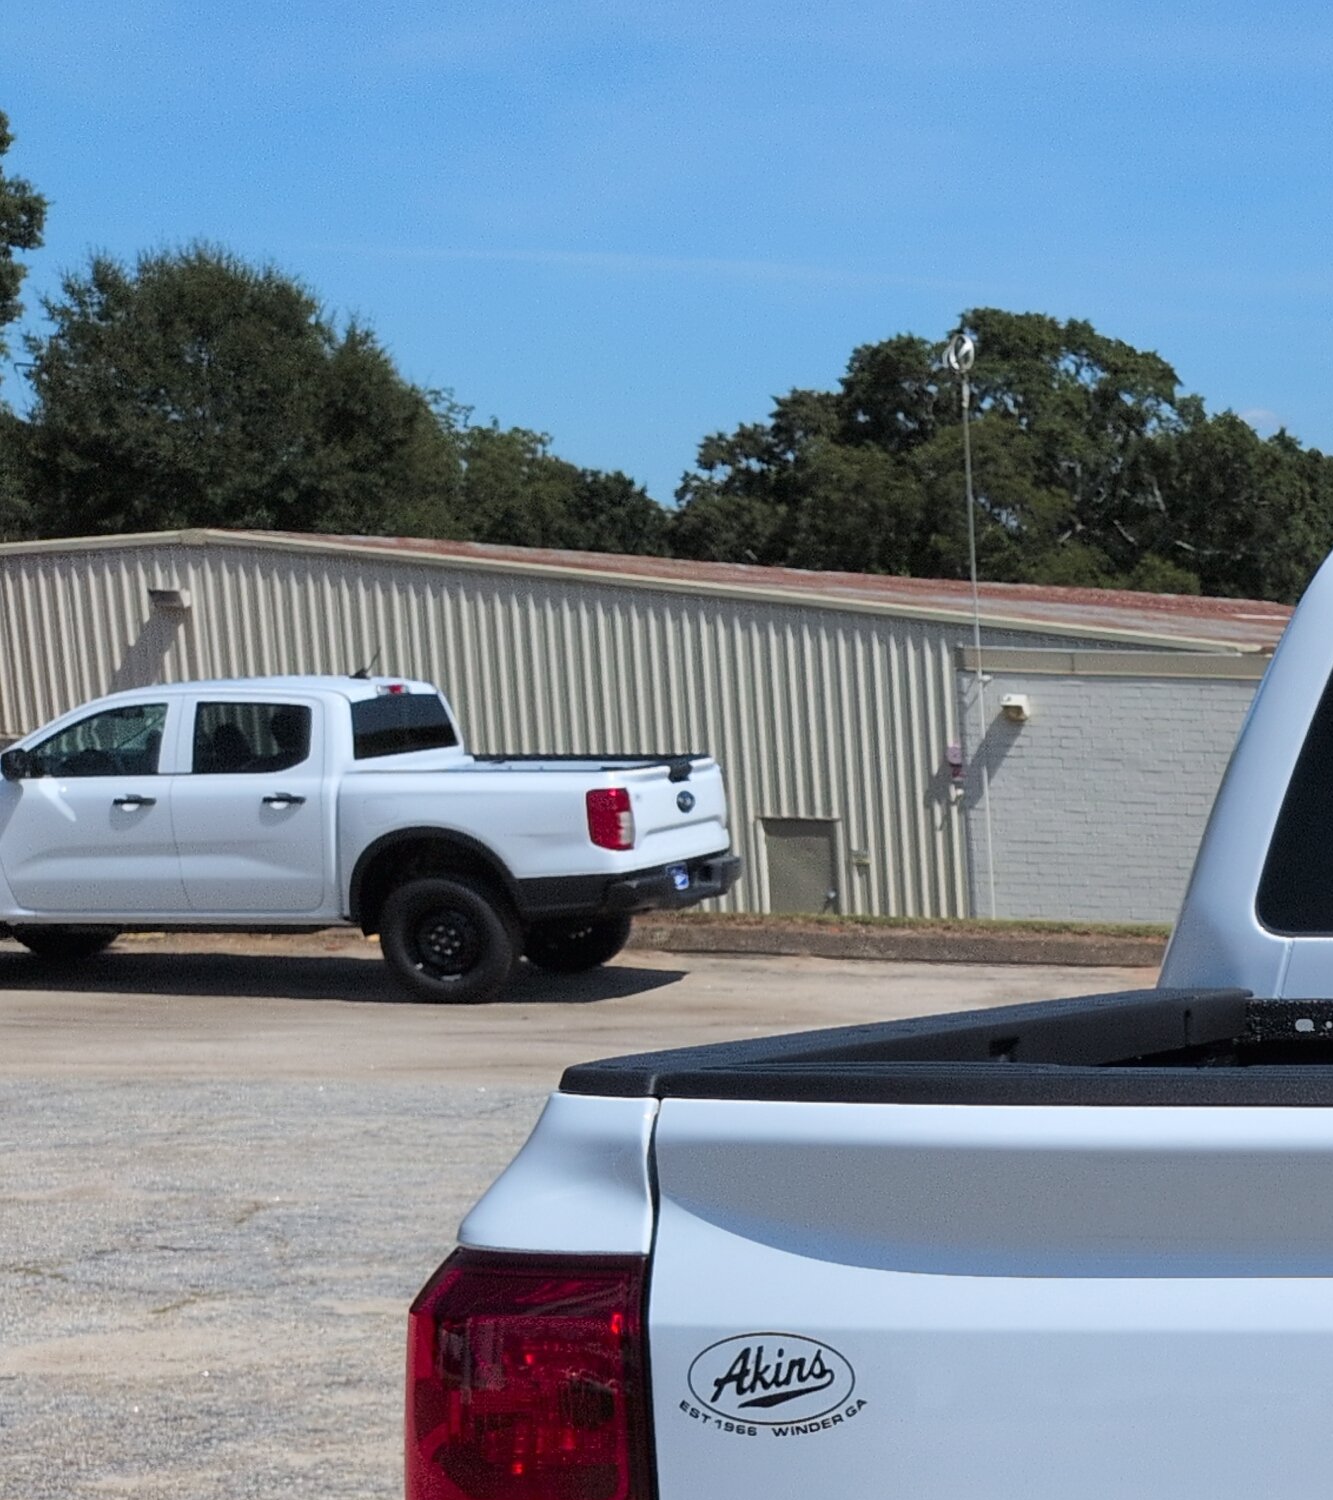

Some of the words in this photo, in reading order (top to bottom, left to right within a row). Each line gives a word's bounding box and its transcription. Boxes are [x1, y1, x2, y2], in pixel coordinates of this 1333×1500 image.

[711, 1345, 834, 1408] Akins
[679, 1400, 711, 1424] EST
[714, 1419, 757, 1437] 1966
[771, 1414, 844, 1437] WINDER
[845, 1399, 868, 1418] GA
